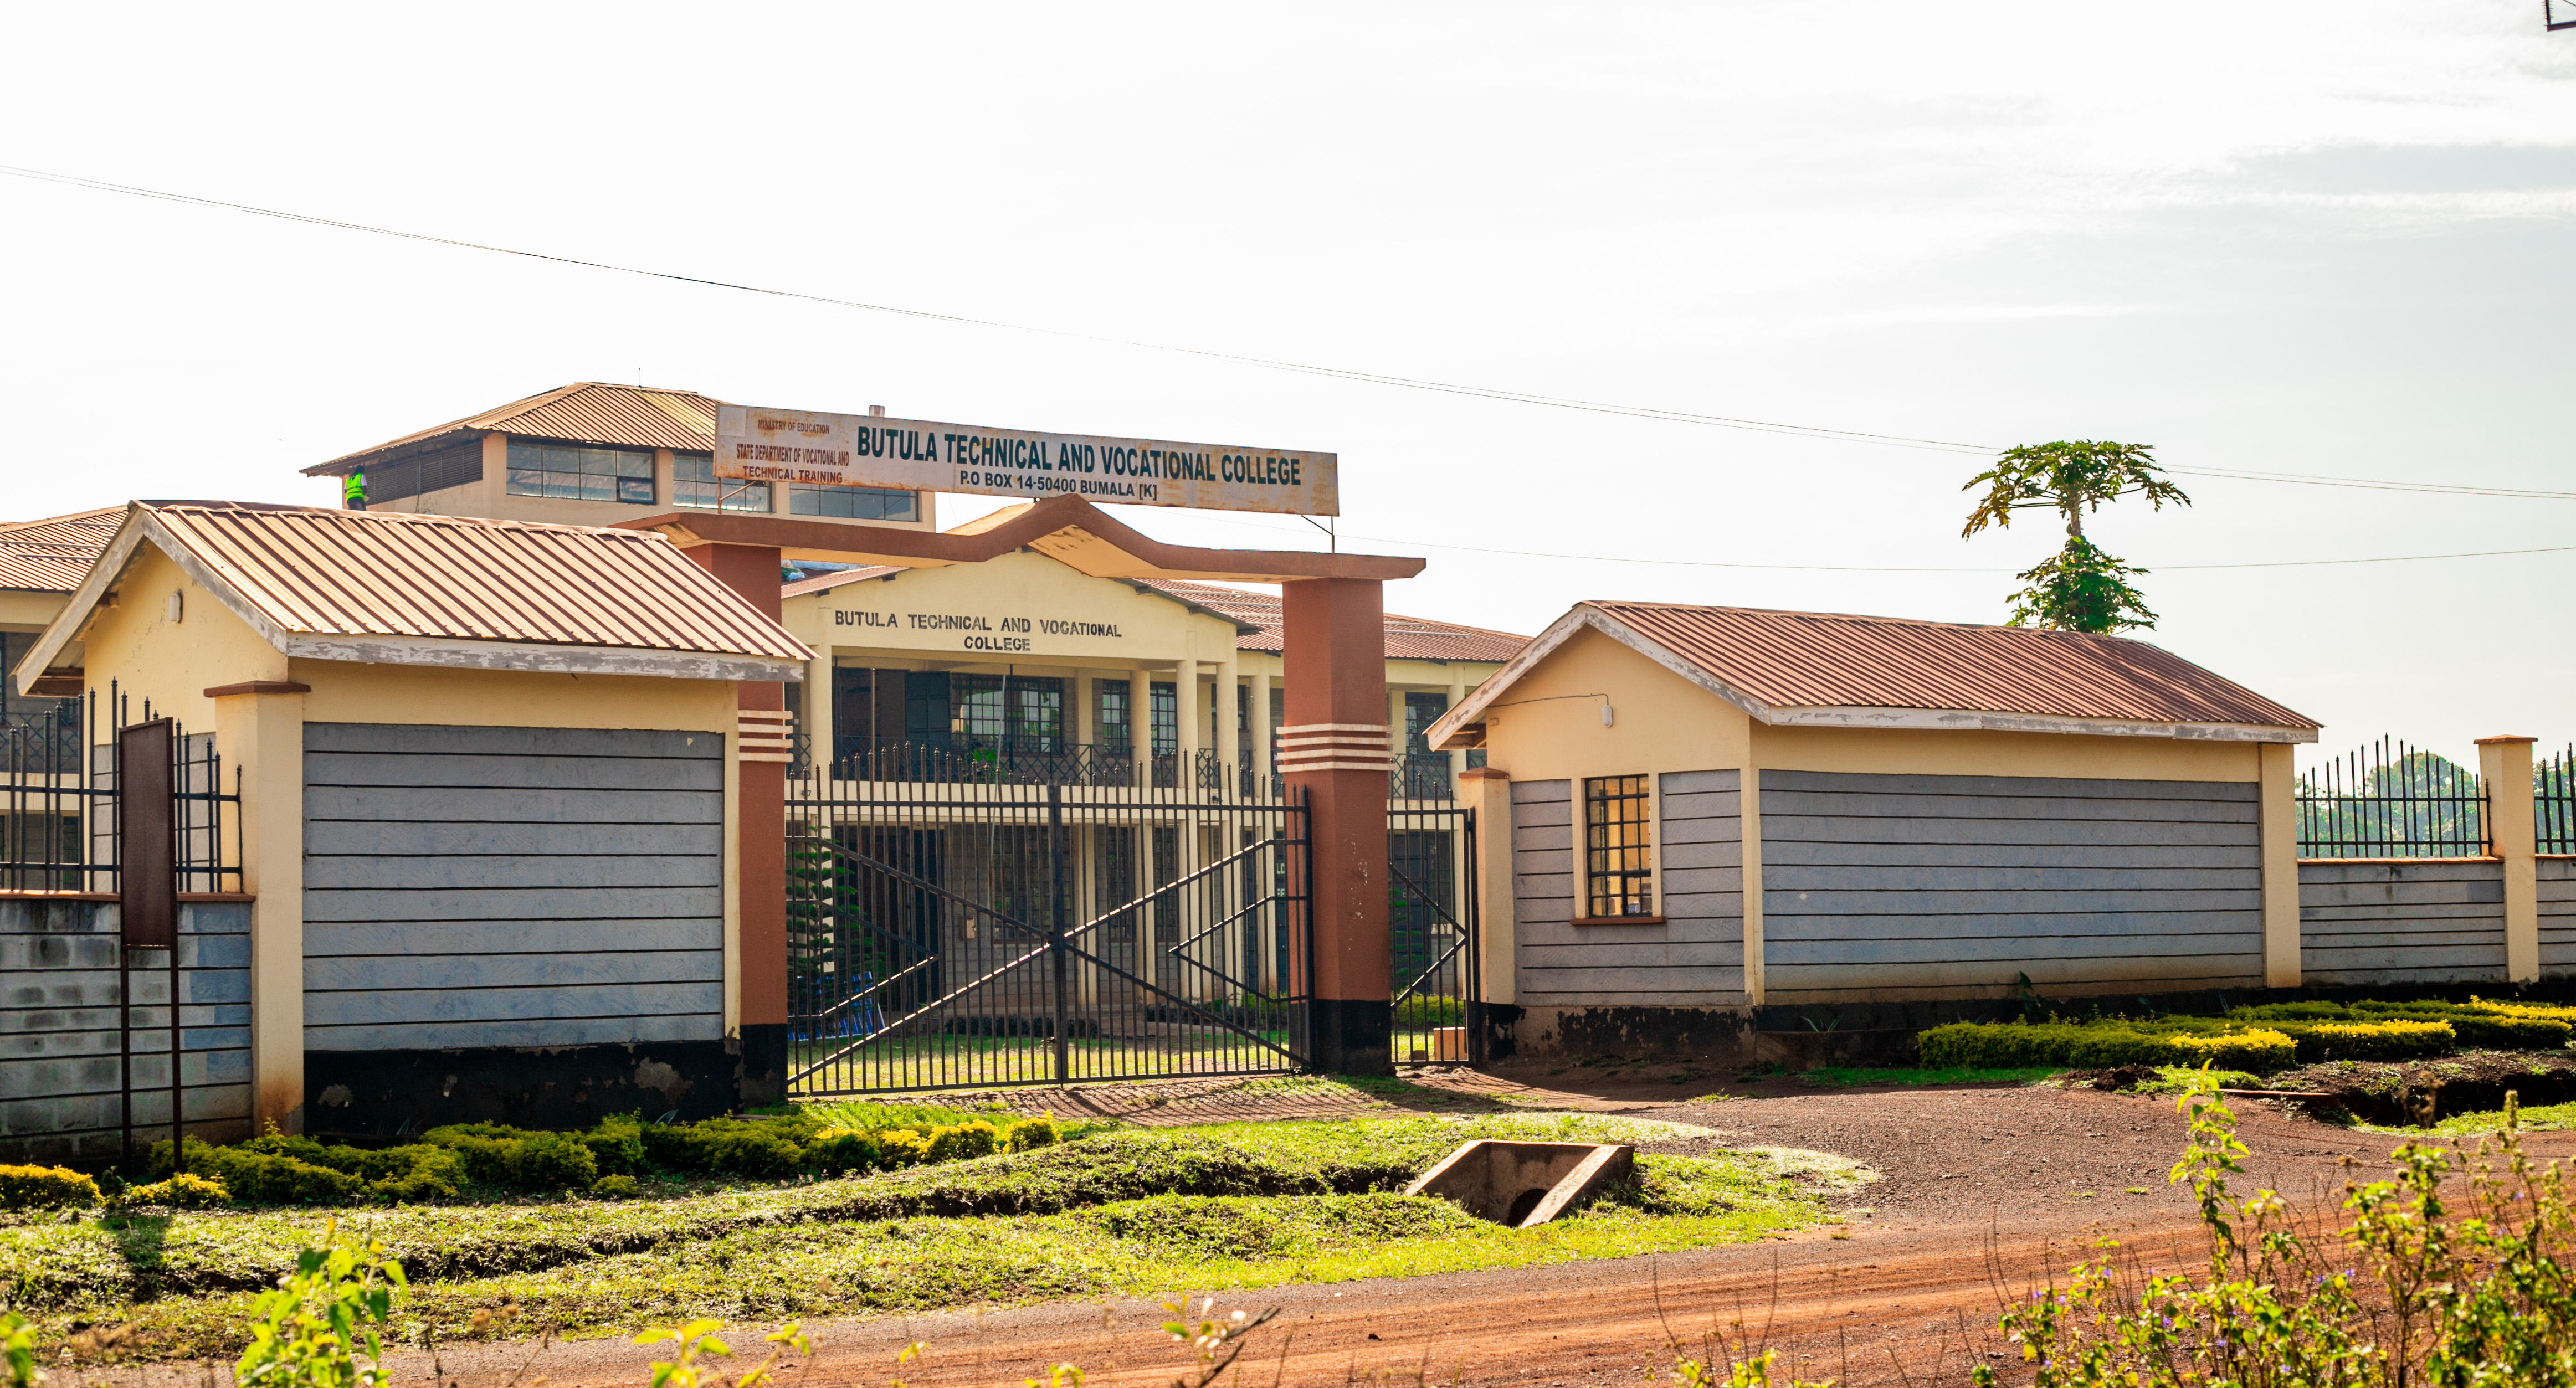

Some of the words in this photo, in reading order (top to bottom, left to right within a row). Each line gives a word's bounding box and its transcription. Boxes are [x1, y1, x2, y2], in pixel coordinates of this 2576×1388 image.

[758, 420, 786, 430] MINISTRY
[788, 423, 796, 431] OF
[798, 423, 830, 434] EDUCATION
[737, 443, 753, 460] STATE
[755, 445, 792, 462] DEPARTMENT
[794, 448, 801, 462] OF
[803, 449, 836, 465] VOCATIONAL
[838, 451, 849, 466] AND
[857, 426, 938, 461] BUTULA
[944, 434, 1053, 470] TECHNICAL
[1058, 443, 1095, 473] AND
[1101, 446, 1215, 481] VOCATIONAL
[1221, 454, 1301, 486] COLLEGE
[743, 466, 795, 480] TECHNICAL
[799, 470, 842, 483] TRAINING
[960, 470, 980, 485] P.O
[984, 473, 1013, 488] BOX
[1017, 474, 1076, 492] 14-50400
[1080, 480, 1135, 496] BUMALA
[1139, 483, 1157, 501] [K]
[835, 611, 898, 628] BUTULA
[909, 614, 992, 631] TECHNICAL
[1001, 618, 1031, 633] AND
[1040, 620, 1122, 637] VOCATIONAL
[964, 636, 1031, 651] COLLEGE
